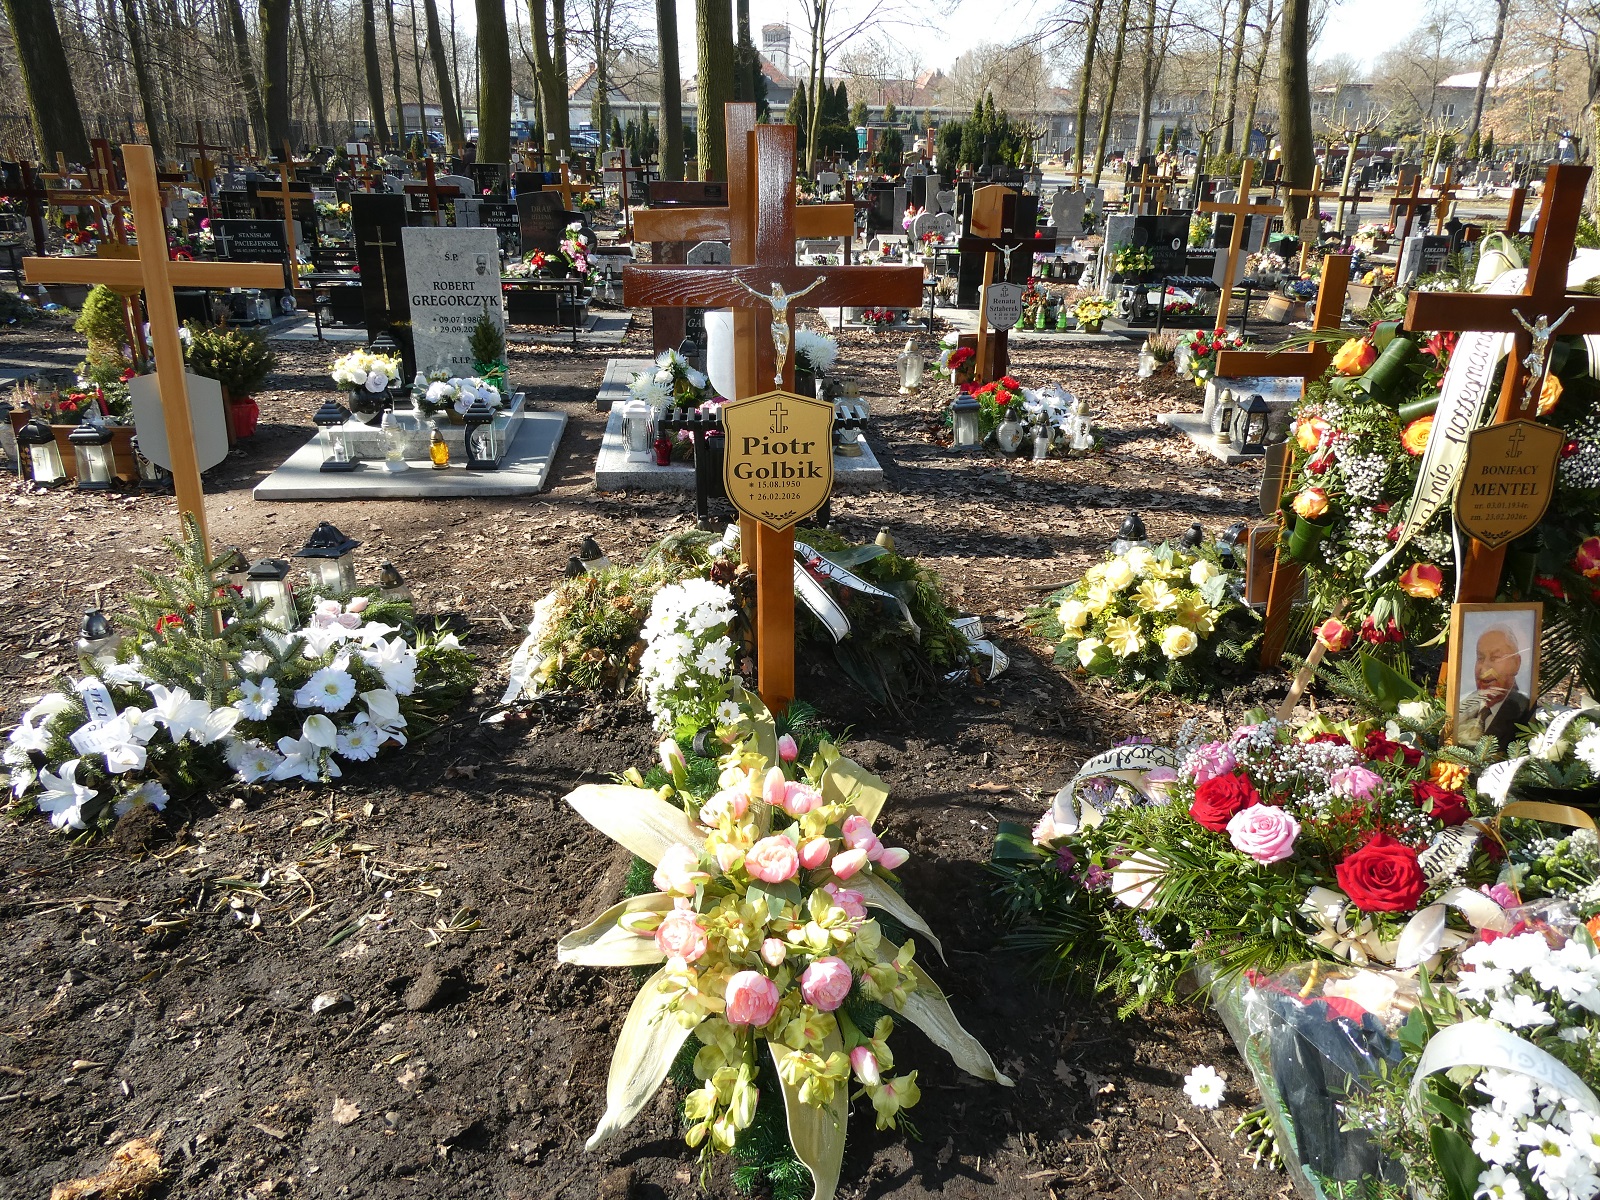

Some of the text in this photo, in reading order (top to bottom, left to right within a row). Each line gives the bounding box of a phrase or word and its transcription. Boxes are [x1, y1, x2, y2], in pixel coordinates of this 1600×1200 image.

[432, 281, 476, 291] ROBERT
[411, 295, 499, 306] GREGORCZYK
[741, 436, 816, 456] Piotr
[733, 461, 823, 480] Golbik
[1481, 465, 1539, 475] BONIFACY
[757, 481, 801, 489] 15.08.1950
[1471, 482, 1540, 496] MENTEL
[757, 493, 801, 501] 26.02.2026
